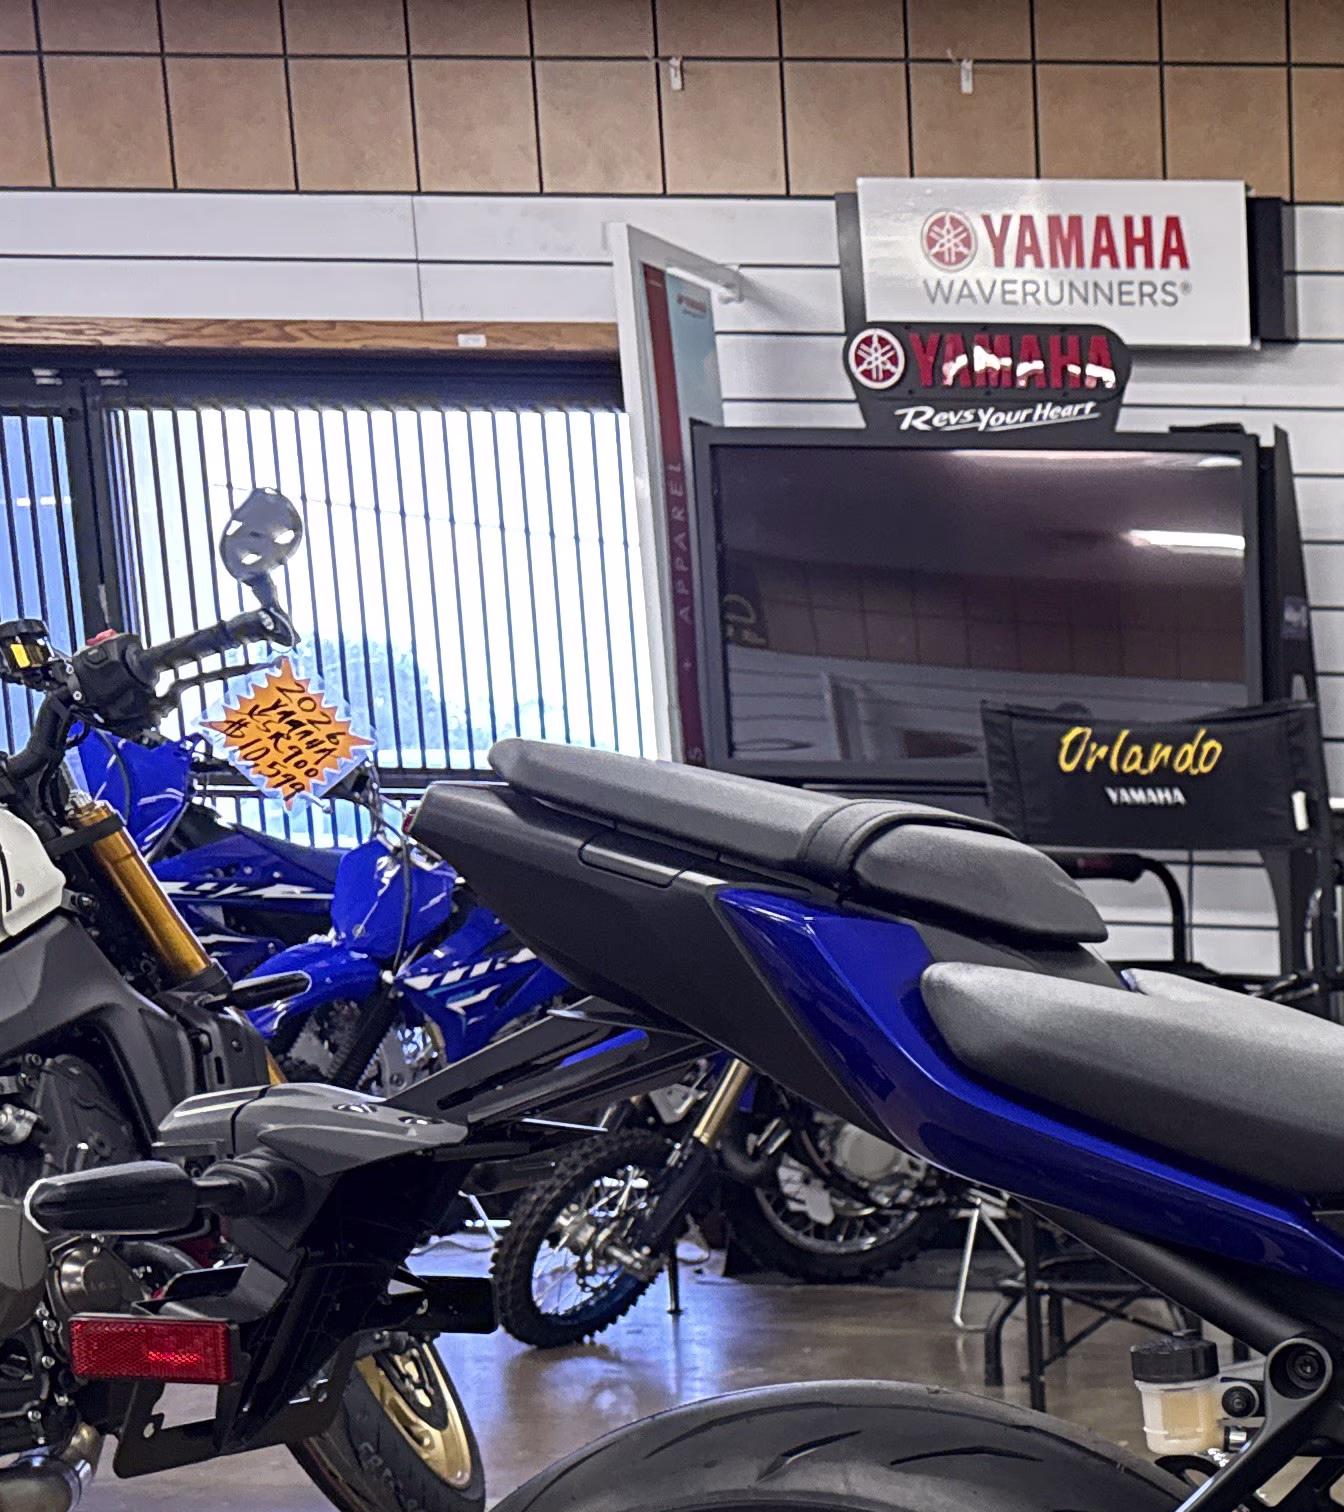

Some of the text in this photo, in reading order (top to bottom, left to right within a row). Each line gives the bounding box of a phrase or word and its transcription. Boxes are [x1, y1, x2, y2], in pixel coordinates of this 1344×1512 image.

[980, 214, 1191, 271] YAMAHA
[908, 331, 1116, 390] YAMAHA
[977, 406, 1035, 432] Your
[667, 462, 693, 625] APPAREL
[276, 682, 347, 746] 2026
[223, 718, 306, 801] $10,599
[282, 745, 319, 778] 700
[1058, 726, 1223, 776] Orlando
[1105, 786, 1187, 806] YAMAHA
